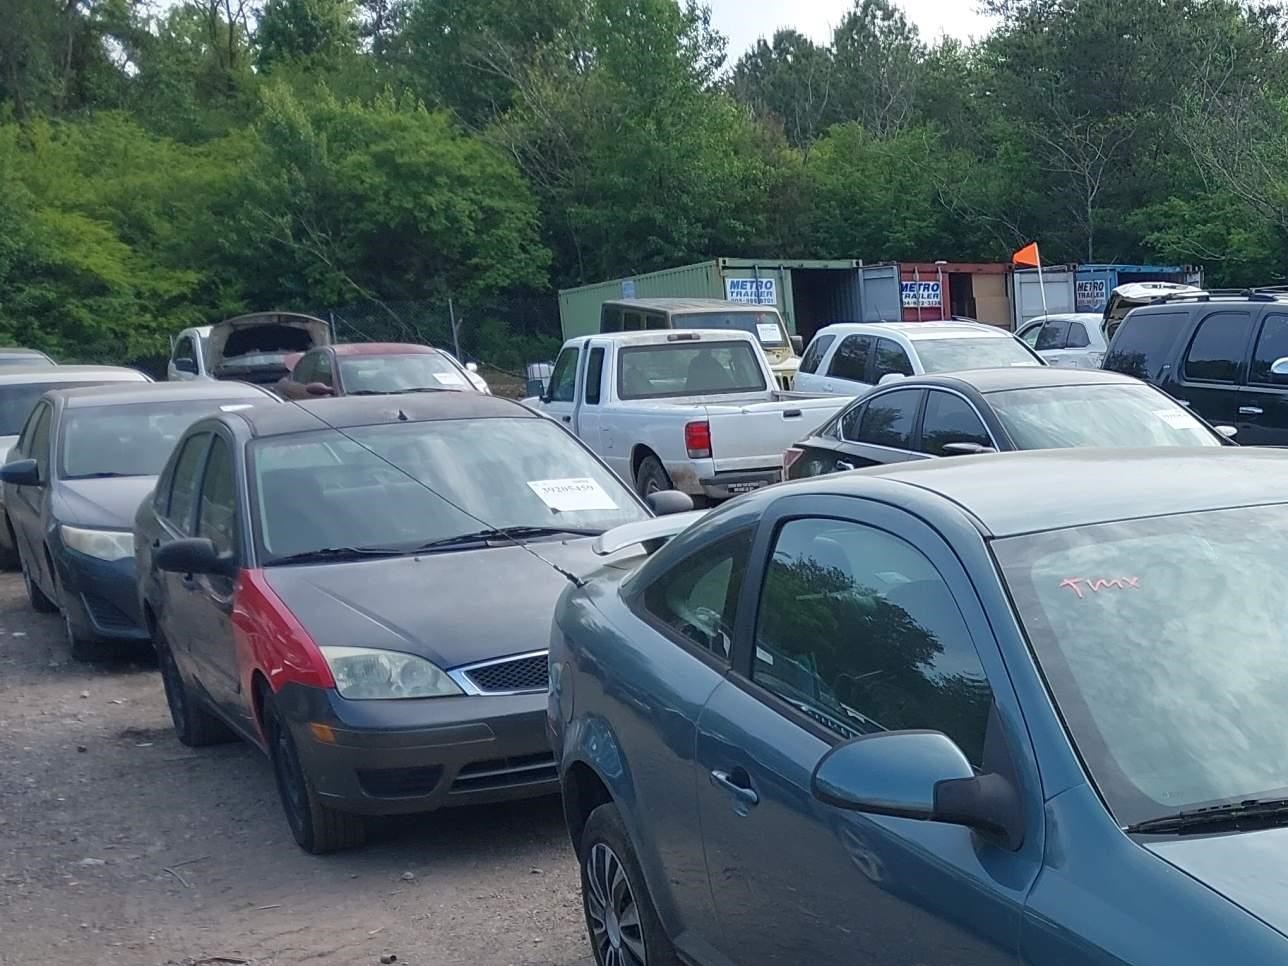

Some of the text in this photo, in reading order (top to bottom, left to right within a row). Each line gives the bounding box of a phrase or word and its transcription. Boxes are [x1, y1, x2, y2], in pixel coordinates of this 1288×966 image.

[729, 280, 773, 291] METRO
[901, 283, 939, 293] METRO
[1077, 281, 1104, 292] METRO
[729, 290, 773, 298] TRAILER
